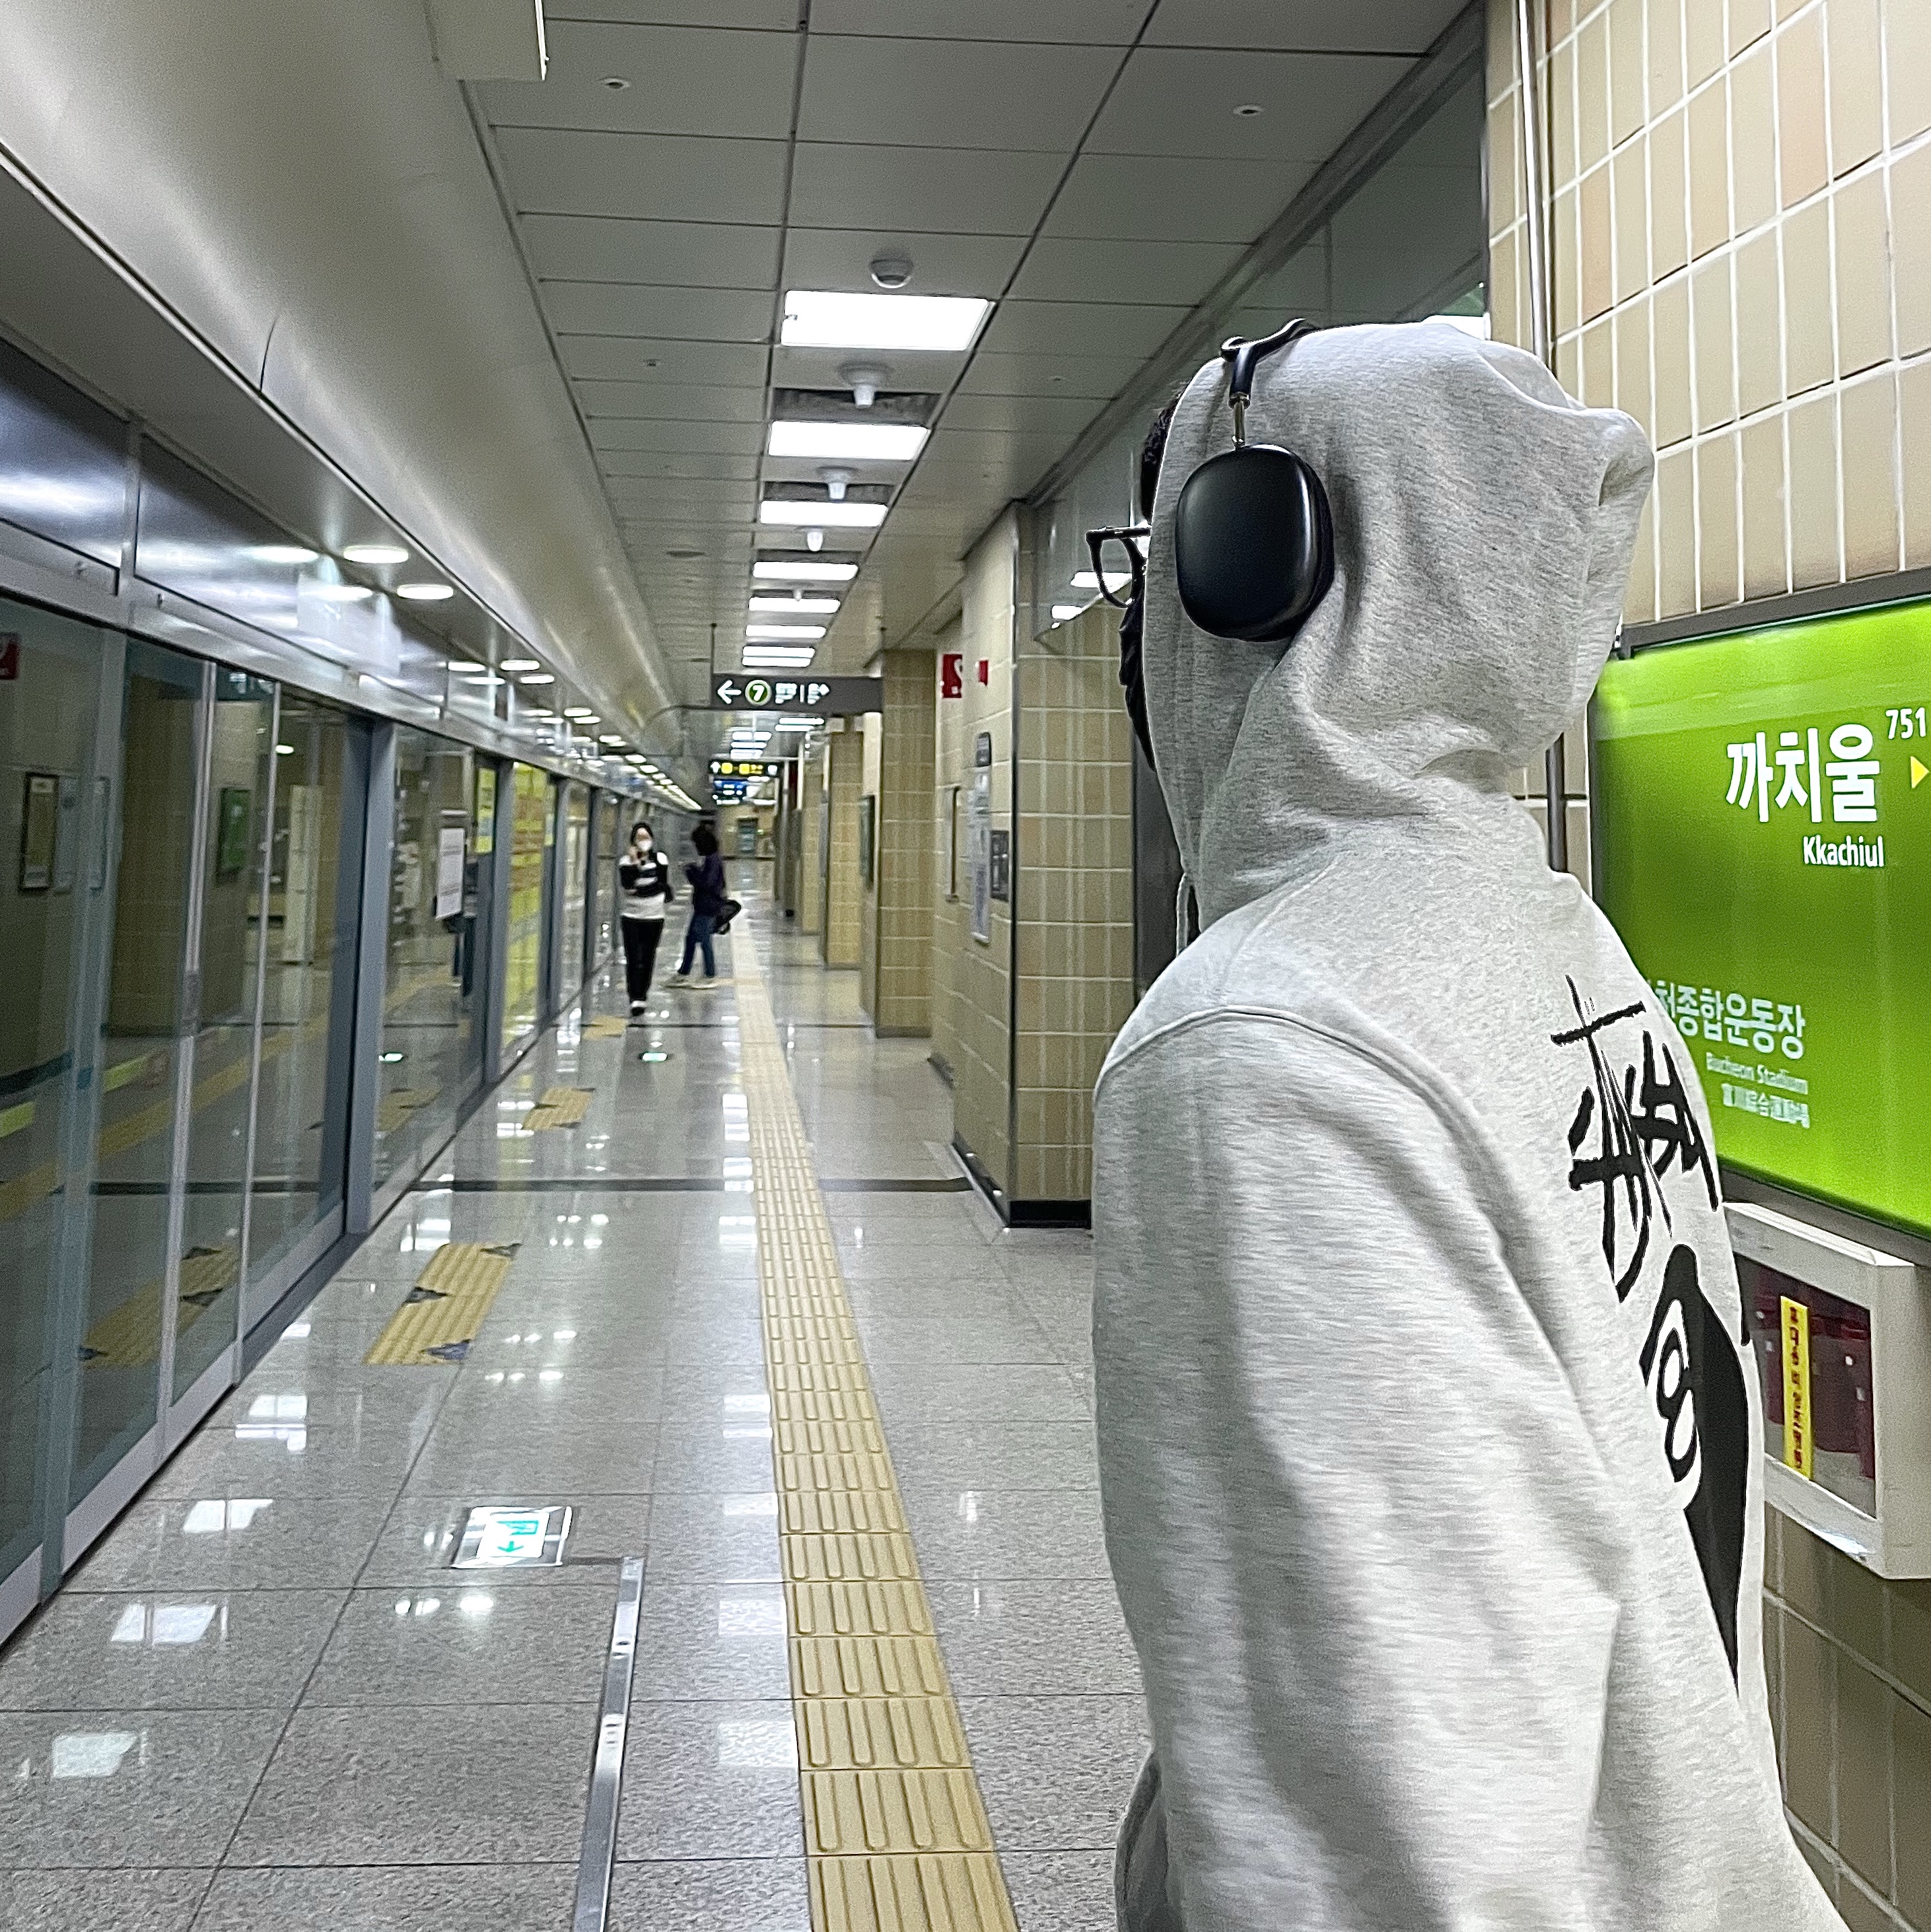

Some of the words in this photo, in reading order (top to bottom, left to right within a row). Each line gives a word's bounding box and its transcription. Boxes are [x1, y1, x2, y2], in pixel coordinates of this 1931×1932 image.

[752, 684, 765, 701] 7
[1885, 707, 1926, 740] 751
[1726, 723, 1880, 823] 까치울
[1803, 835, 1885, 867] Kkachiul
